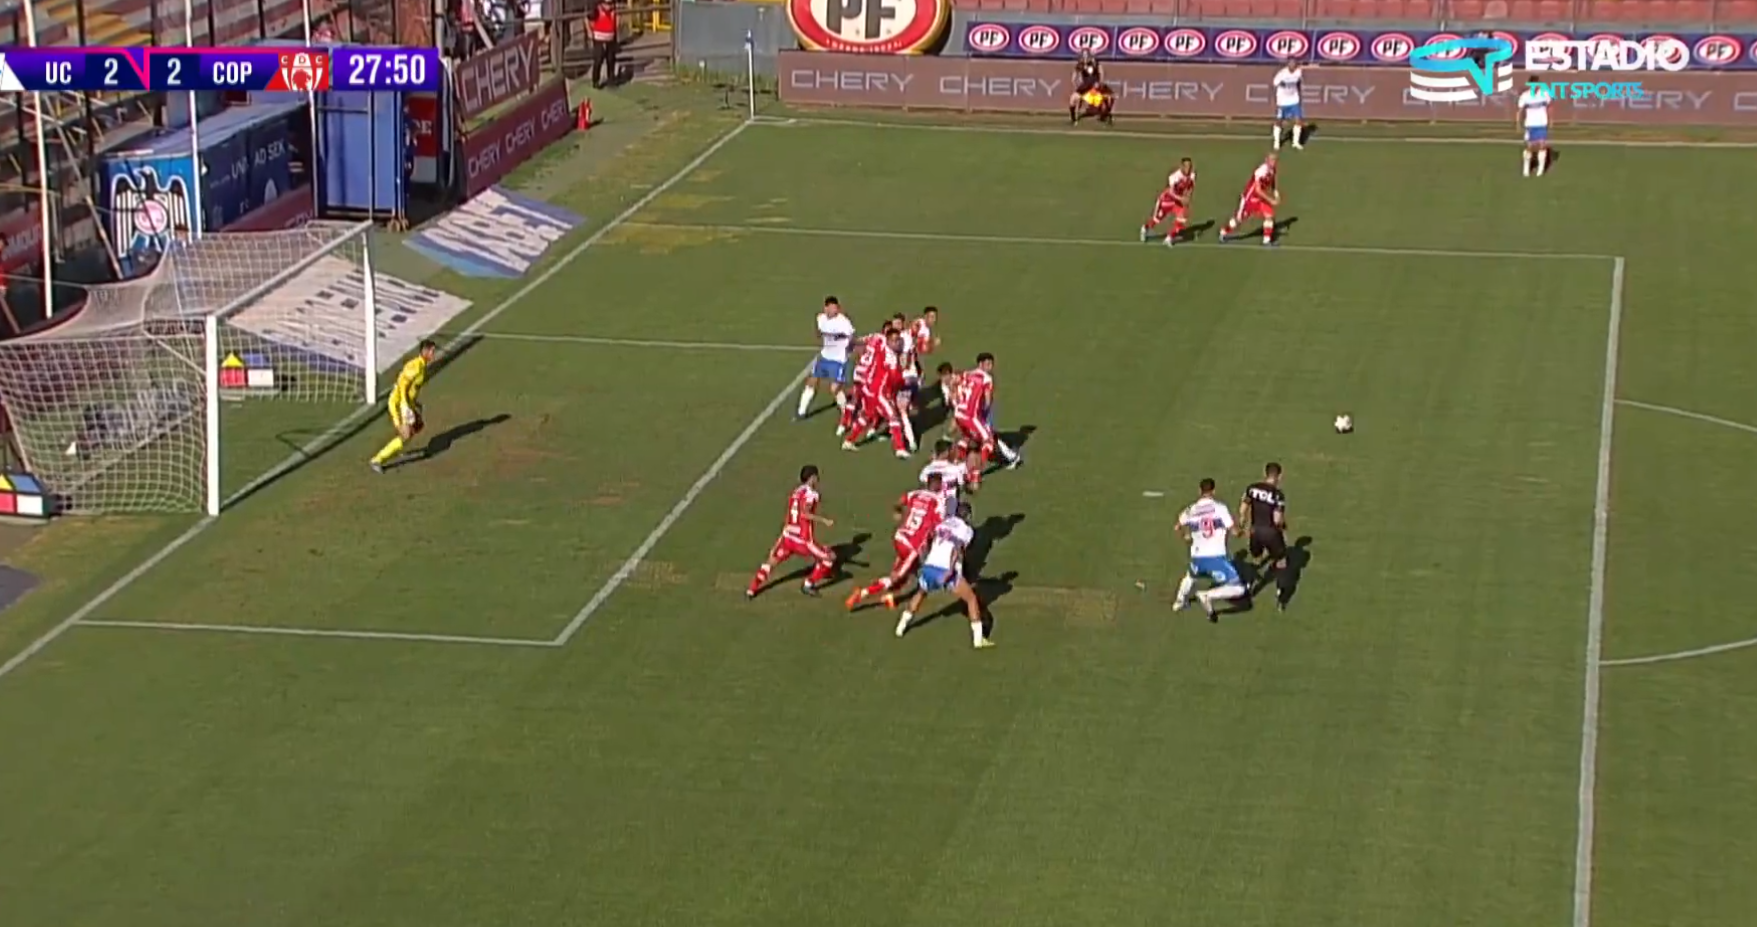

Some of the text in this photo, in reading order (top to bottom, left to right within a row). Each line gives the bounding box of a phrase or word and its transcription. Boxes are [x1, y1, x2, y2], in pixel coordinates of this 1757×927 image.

[461, 40, 534, 112] CHERY
[791, 69, 914, 92] CHERY
[939, 76, 1061, 97] CHERY
[1245, 83, 1376, 105] CERY
[468, 138, 502, 178] CHERY
[505, 117, 537, 154] CHERY
[1251, 488, 1275, 504] TCL
[907, 506, 926, 533] 15
[1200, 515, 1214, 539] 9
